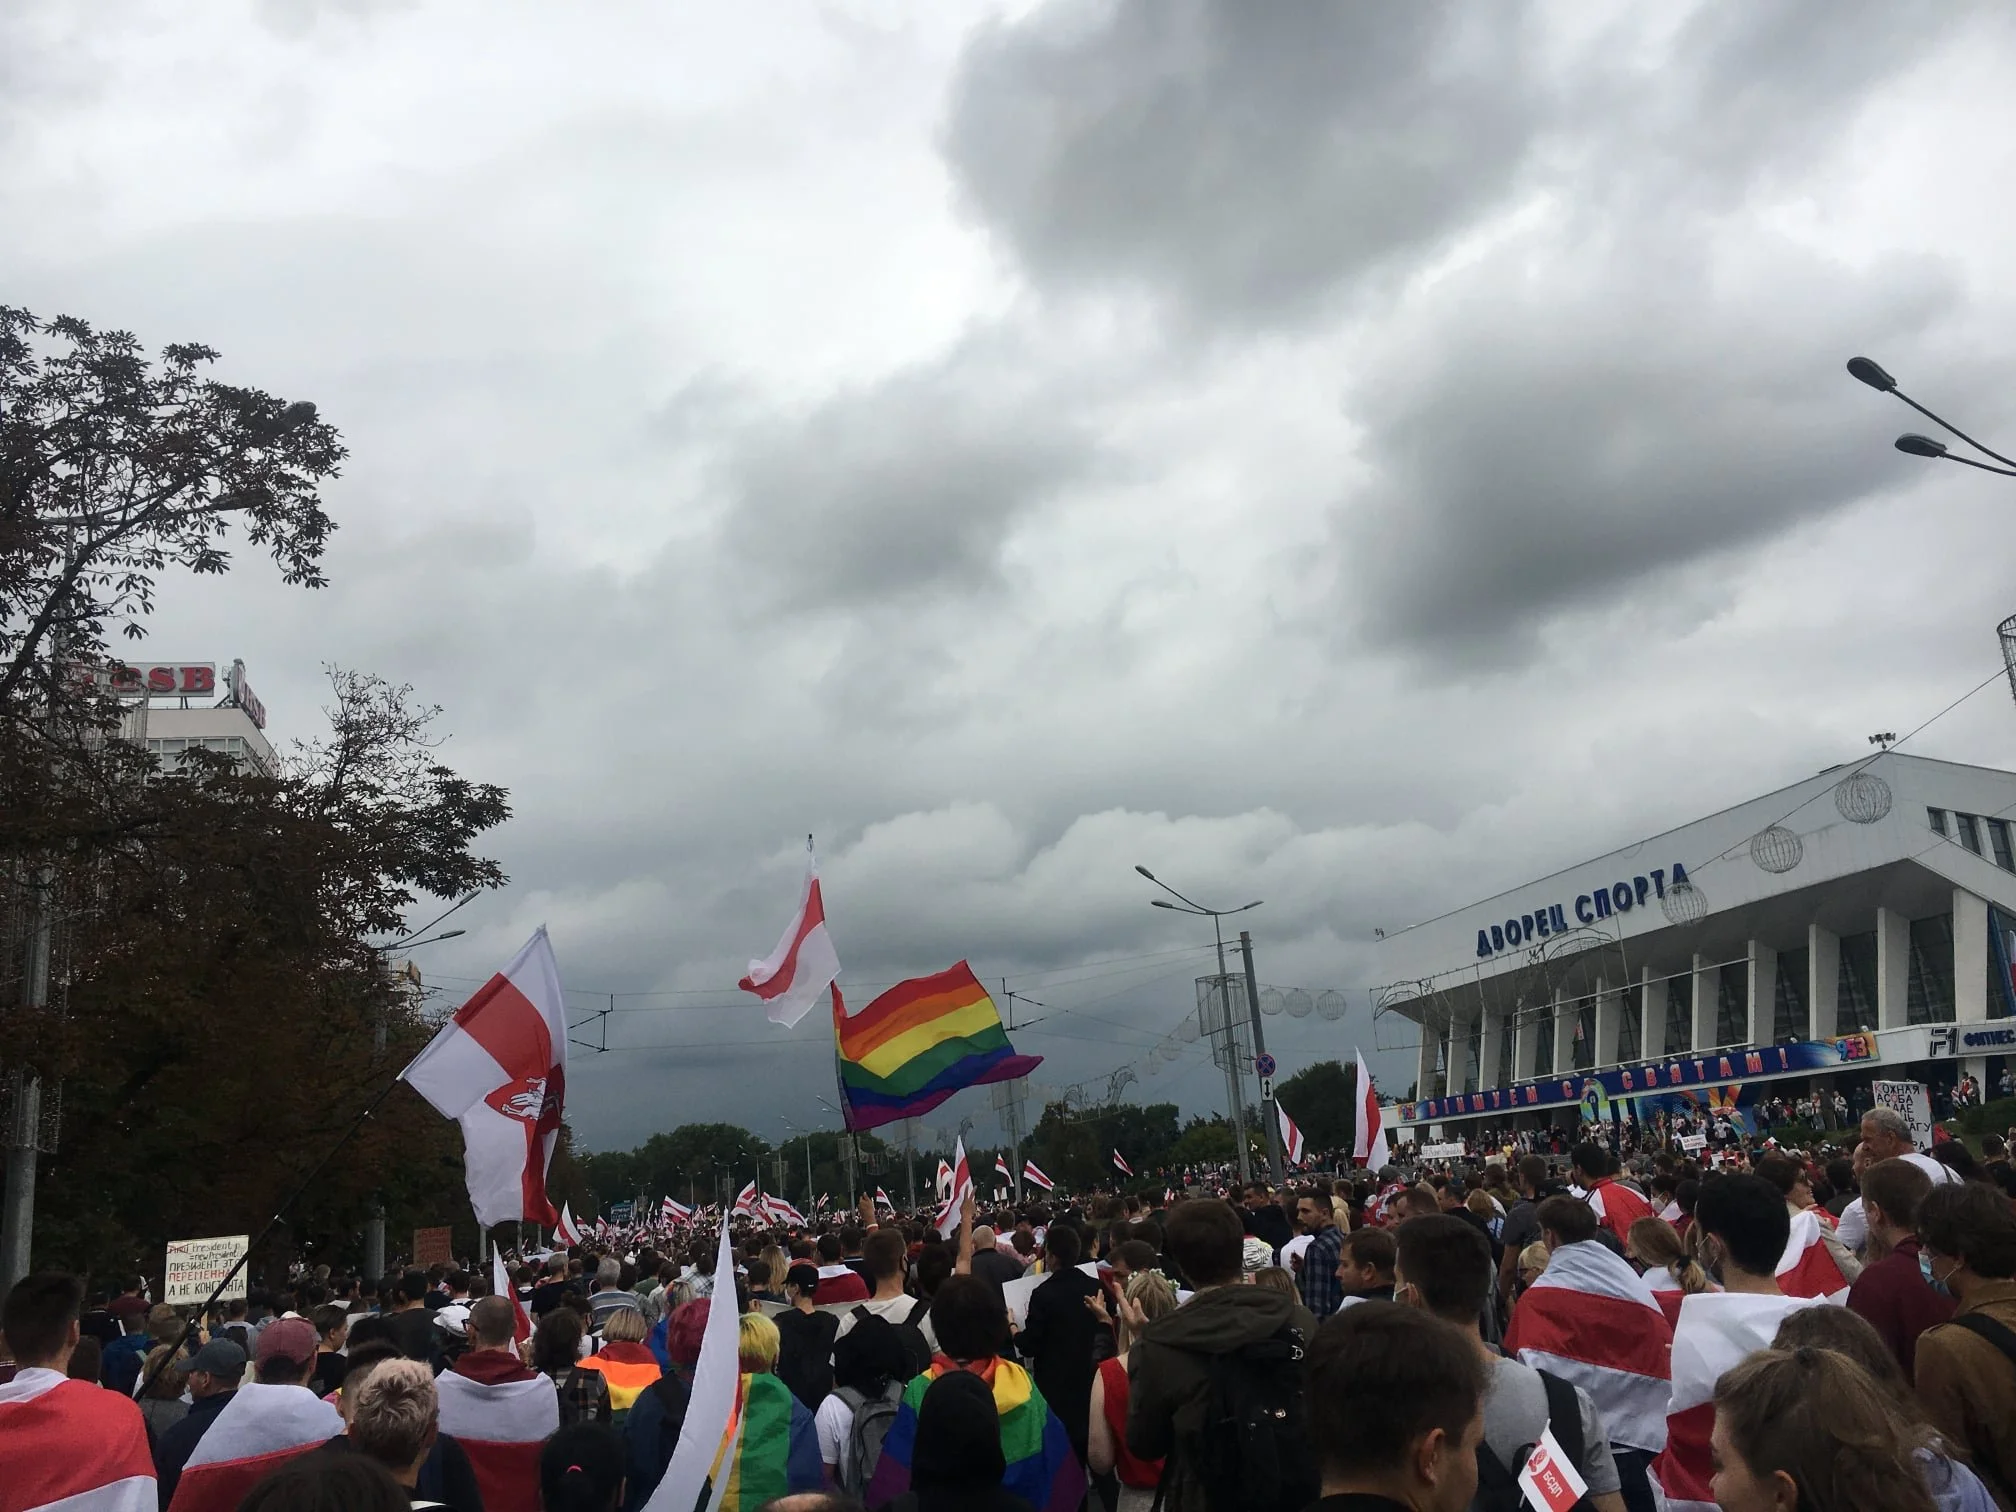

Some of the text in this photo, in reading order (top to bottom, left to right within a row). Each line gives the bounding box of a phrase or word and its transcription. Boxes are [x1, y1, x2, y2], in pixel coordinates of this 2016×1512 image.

[1476, 862, 1693, 958] ДВОРЕЦ СПОРТА
[1877, 1093, 1914, 1104] АСОБА
[168, 1269, 237, 1282] ПЕРЕМЕННА
[168, 1279, 244, 1296] А НЕ КОНСНТА
[1543, 1470, 1563, 1498] БСДП
